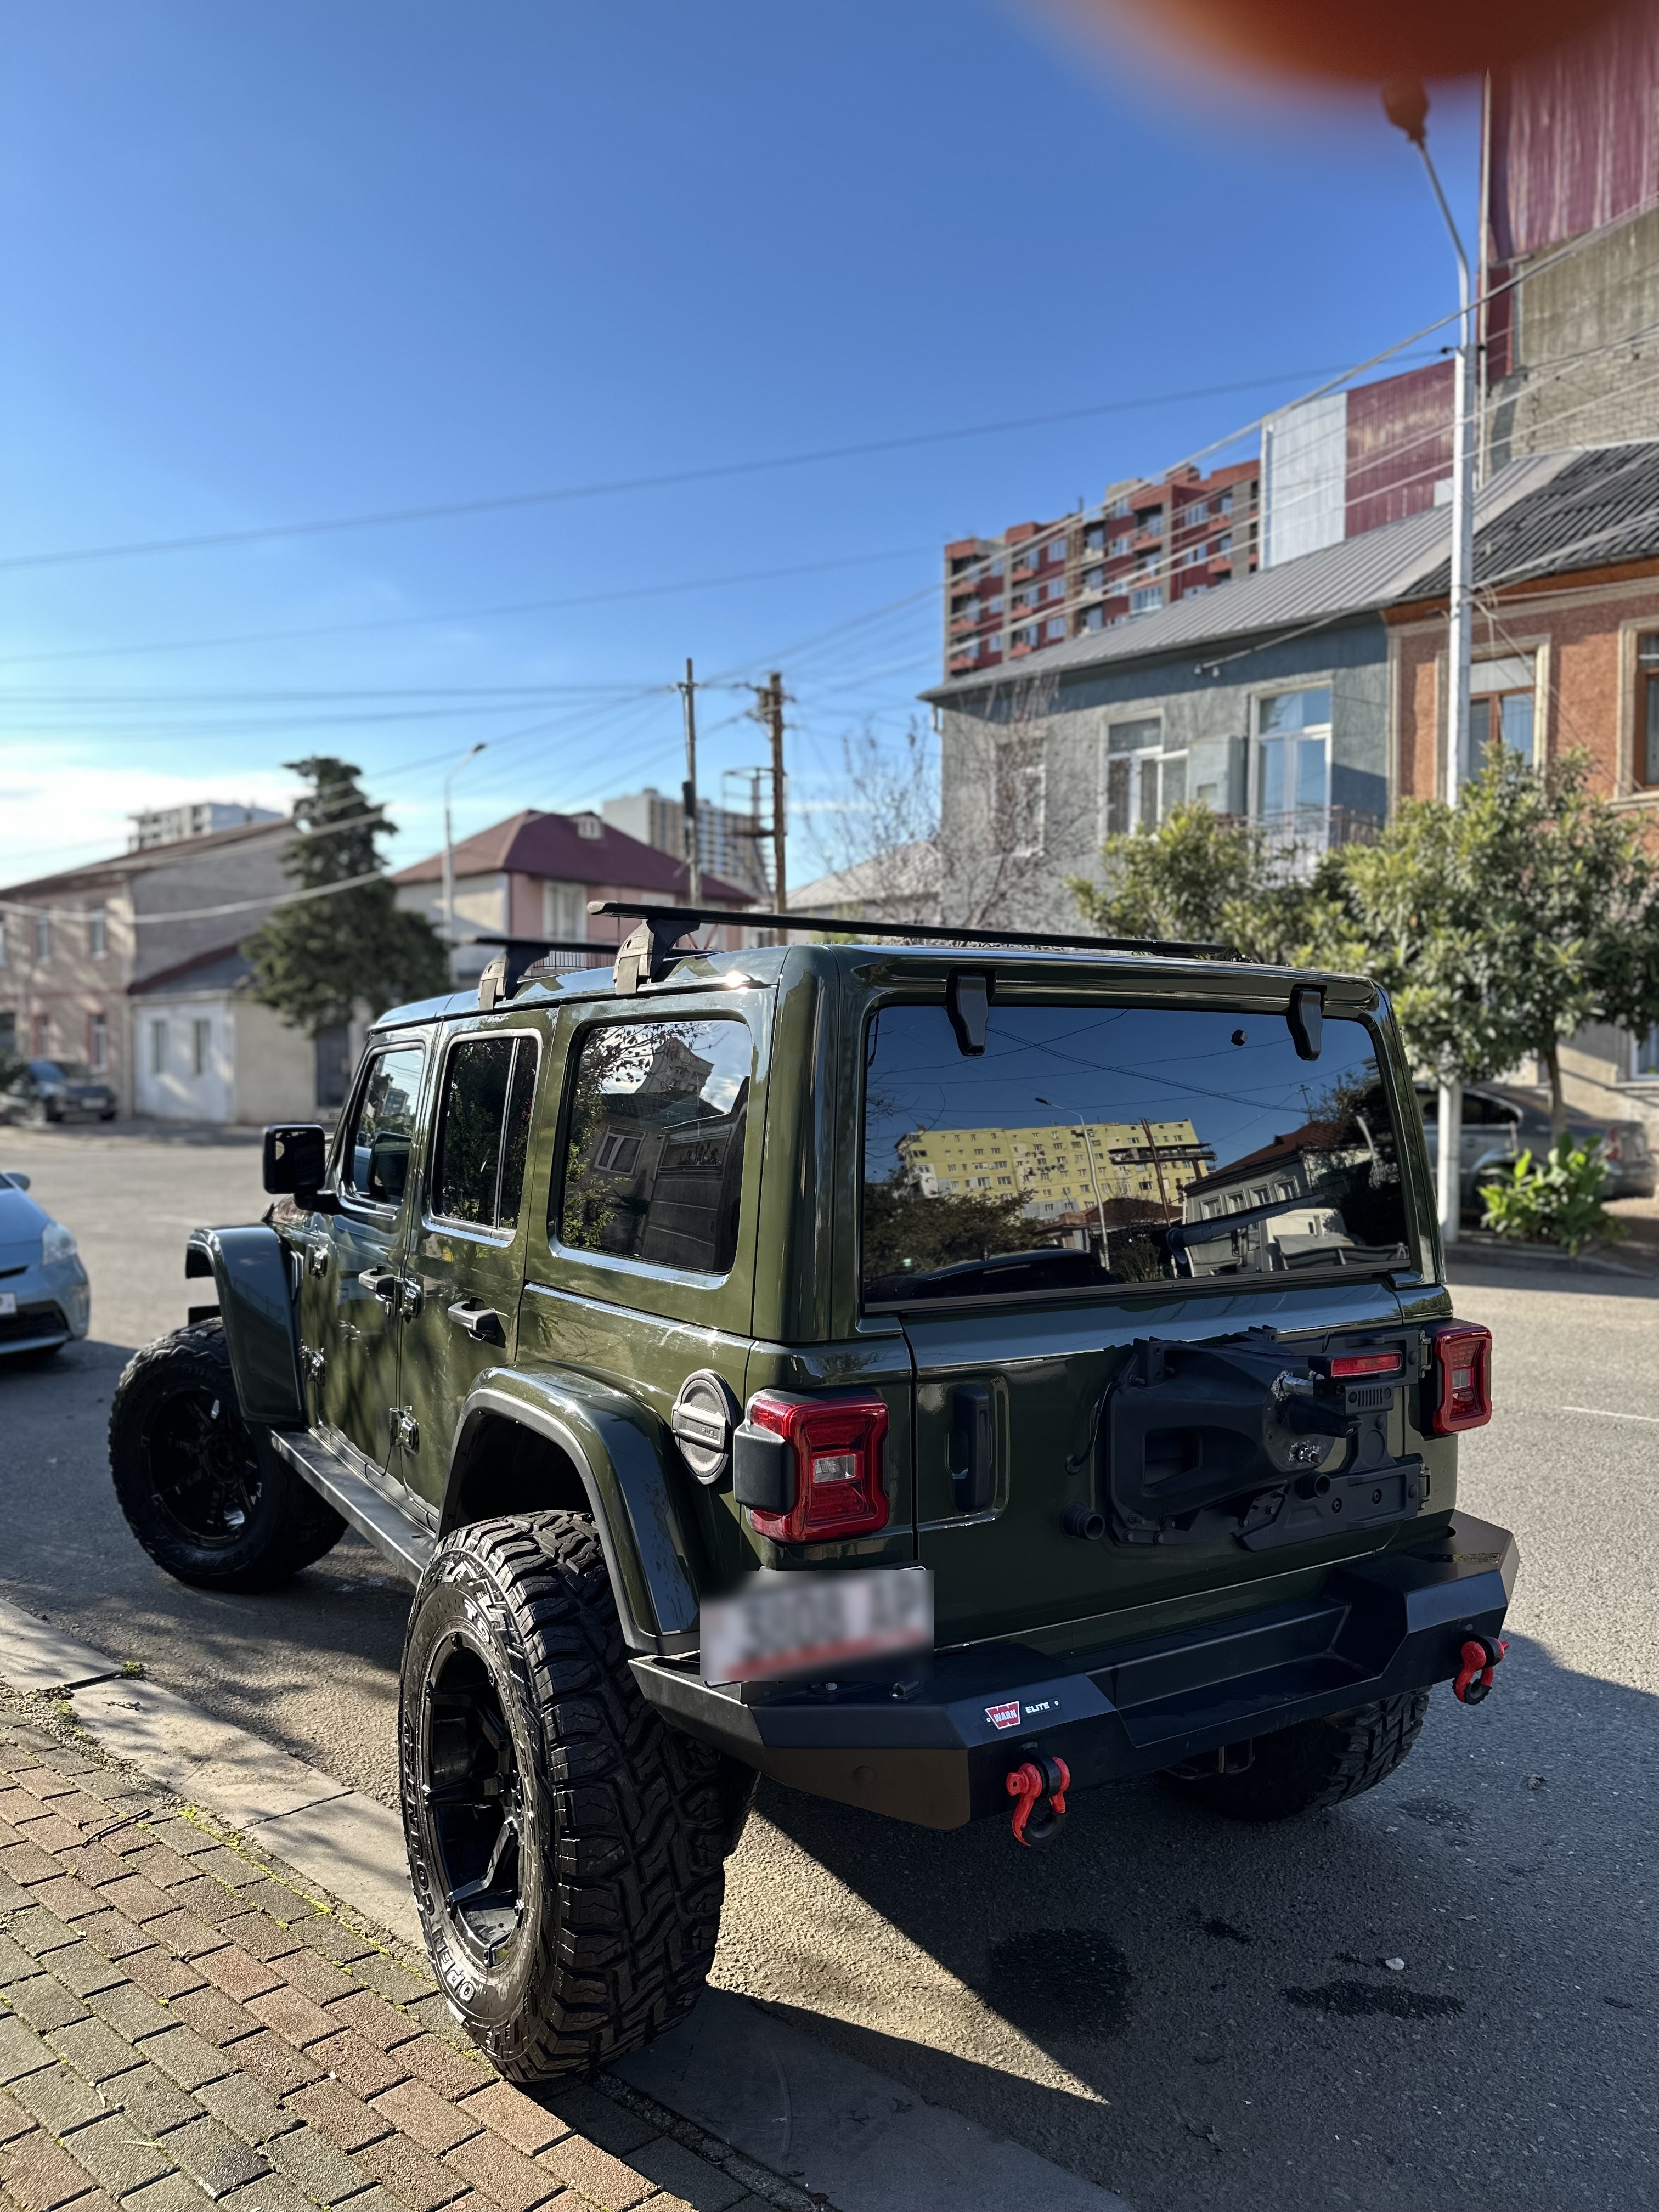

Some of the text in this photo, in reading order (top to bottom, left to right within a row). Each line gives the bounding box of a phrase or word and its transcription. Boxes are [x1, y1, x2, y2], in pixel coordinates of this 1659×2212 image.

[701, 1427, 717, 1437] FUEL
[994, 1702, 1050, 1722] WARN ELITE
[404, 1710, 477, 2004] OPEN COUNTRY
